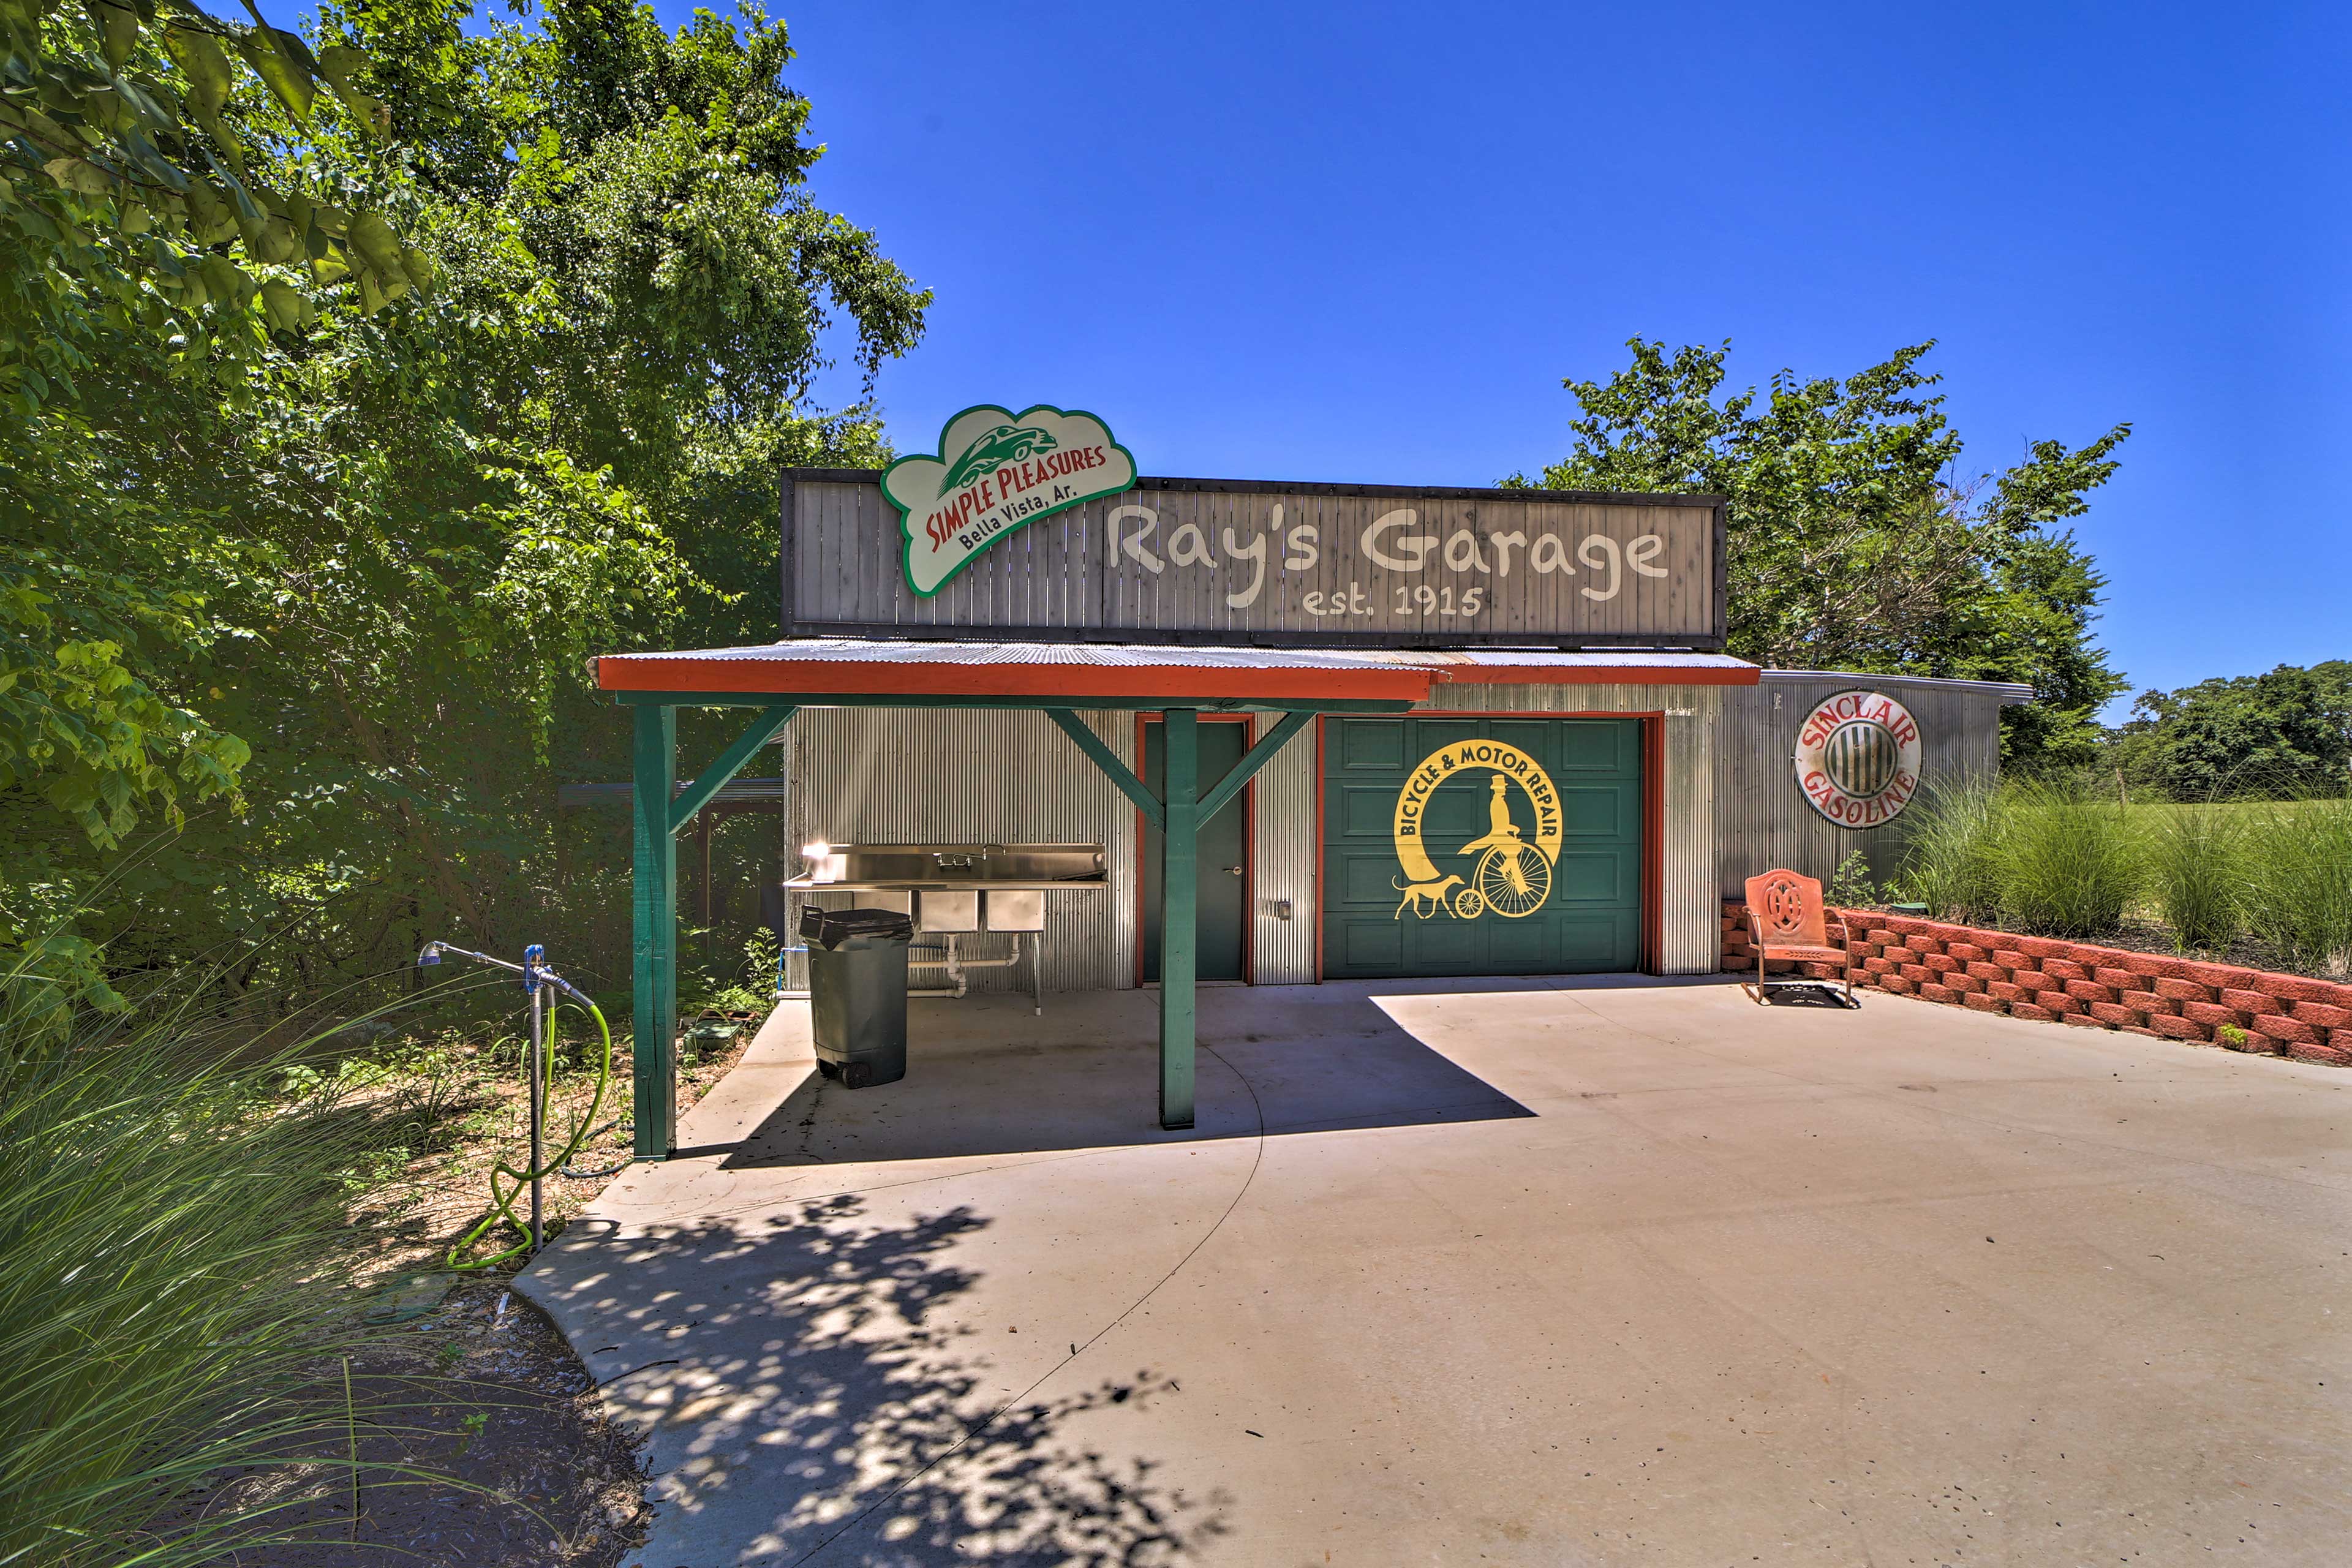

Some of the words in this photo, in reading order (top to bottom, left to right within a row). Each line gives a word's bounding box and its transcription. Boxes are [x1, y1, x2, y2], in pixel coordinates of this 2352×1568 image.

[926, 480, 995, 553] SIMPLE
[997, 446, 1106, 500] PLEASURES
[959, 517, 1001, 551] Bella
[1000, 497, 1050, 522] Vista,
[1054, 484, 1077, 502] Ar.
[1108, 503, 1319, 608] Ray's
[1361, 508, 1669, 601] Garage
[1303, 581, 1374, 616] est.
[1396, 586, 1485, 616] 1915
[1802, 695, 1916, 750] SINCLAIR
[1400, 764, 1440, 835] BICYCLE
[1441, 754, 1456, 771] &
[1461, 746, 1528, 777] MOTOR
[1526, 773, 1557, 837] REPAIR
[1804, 771, 1915, 824] GASOLINE
